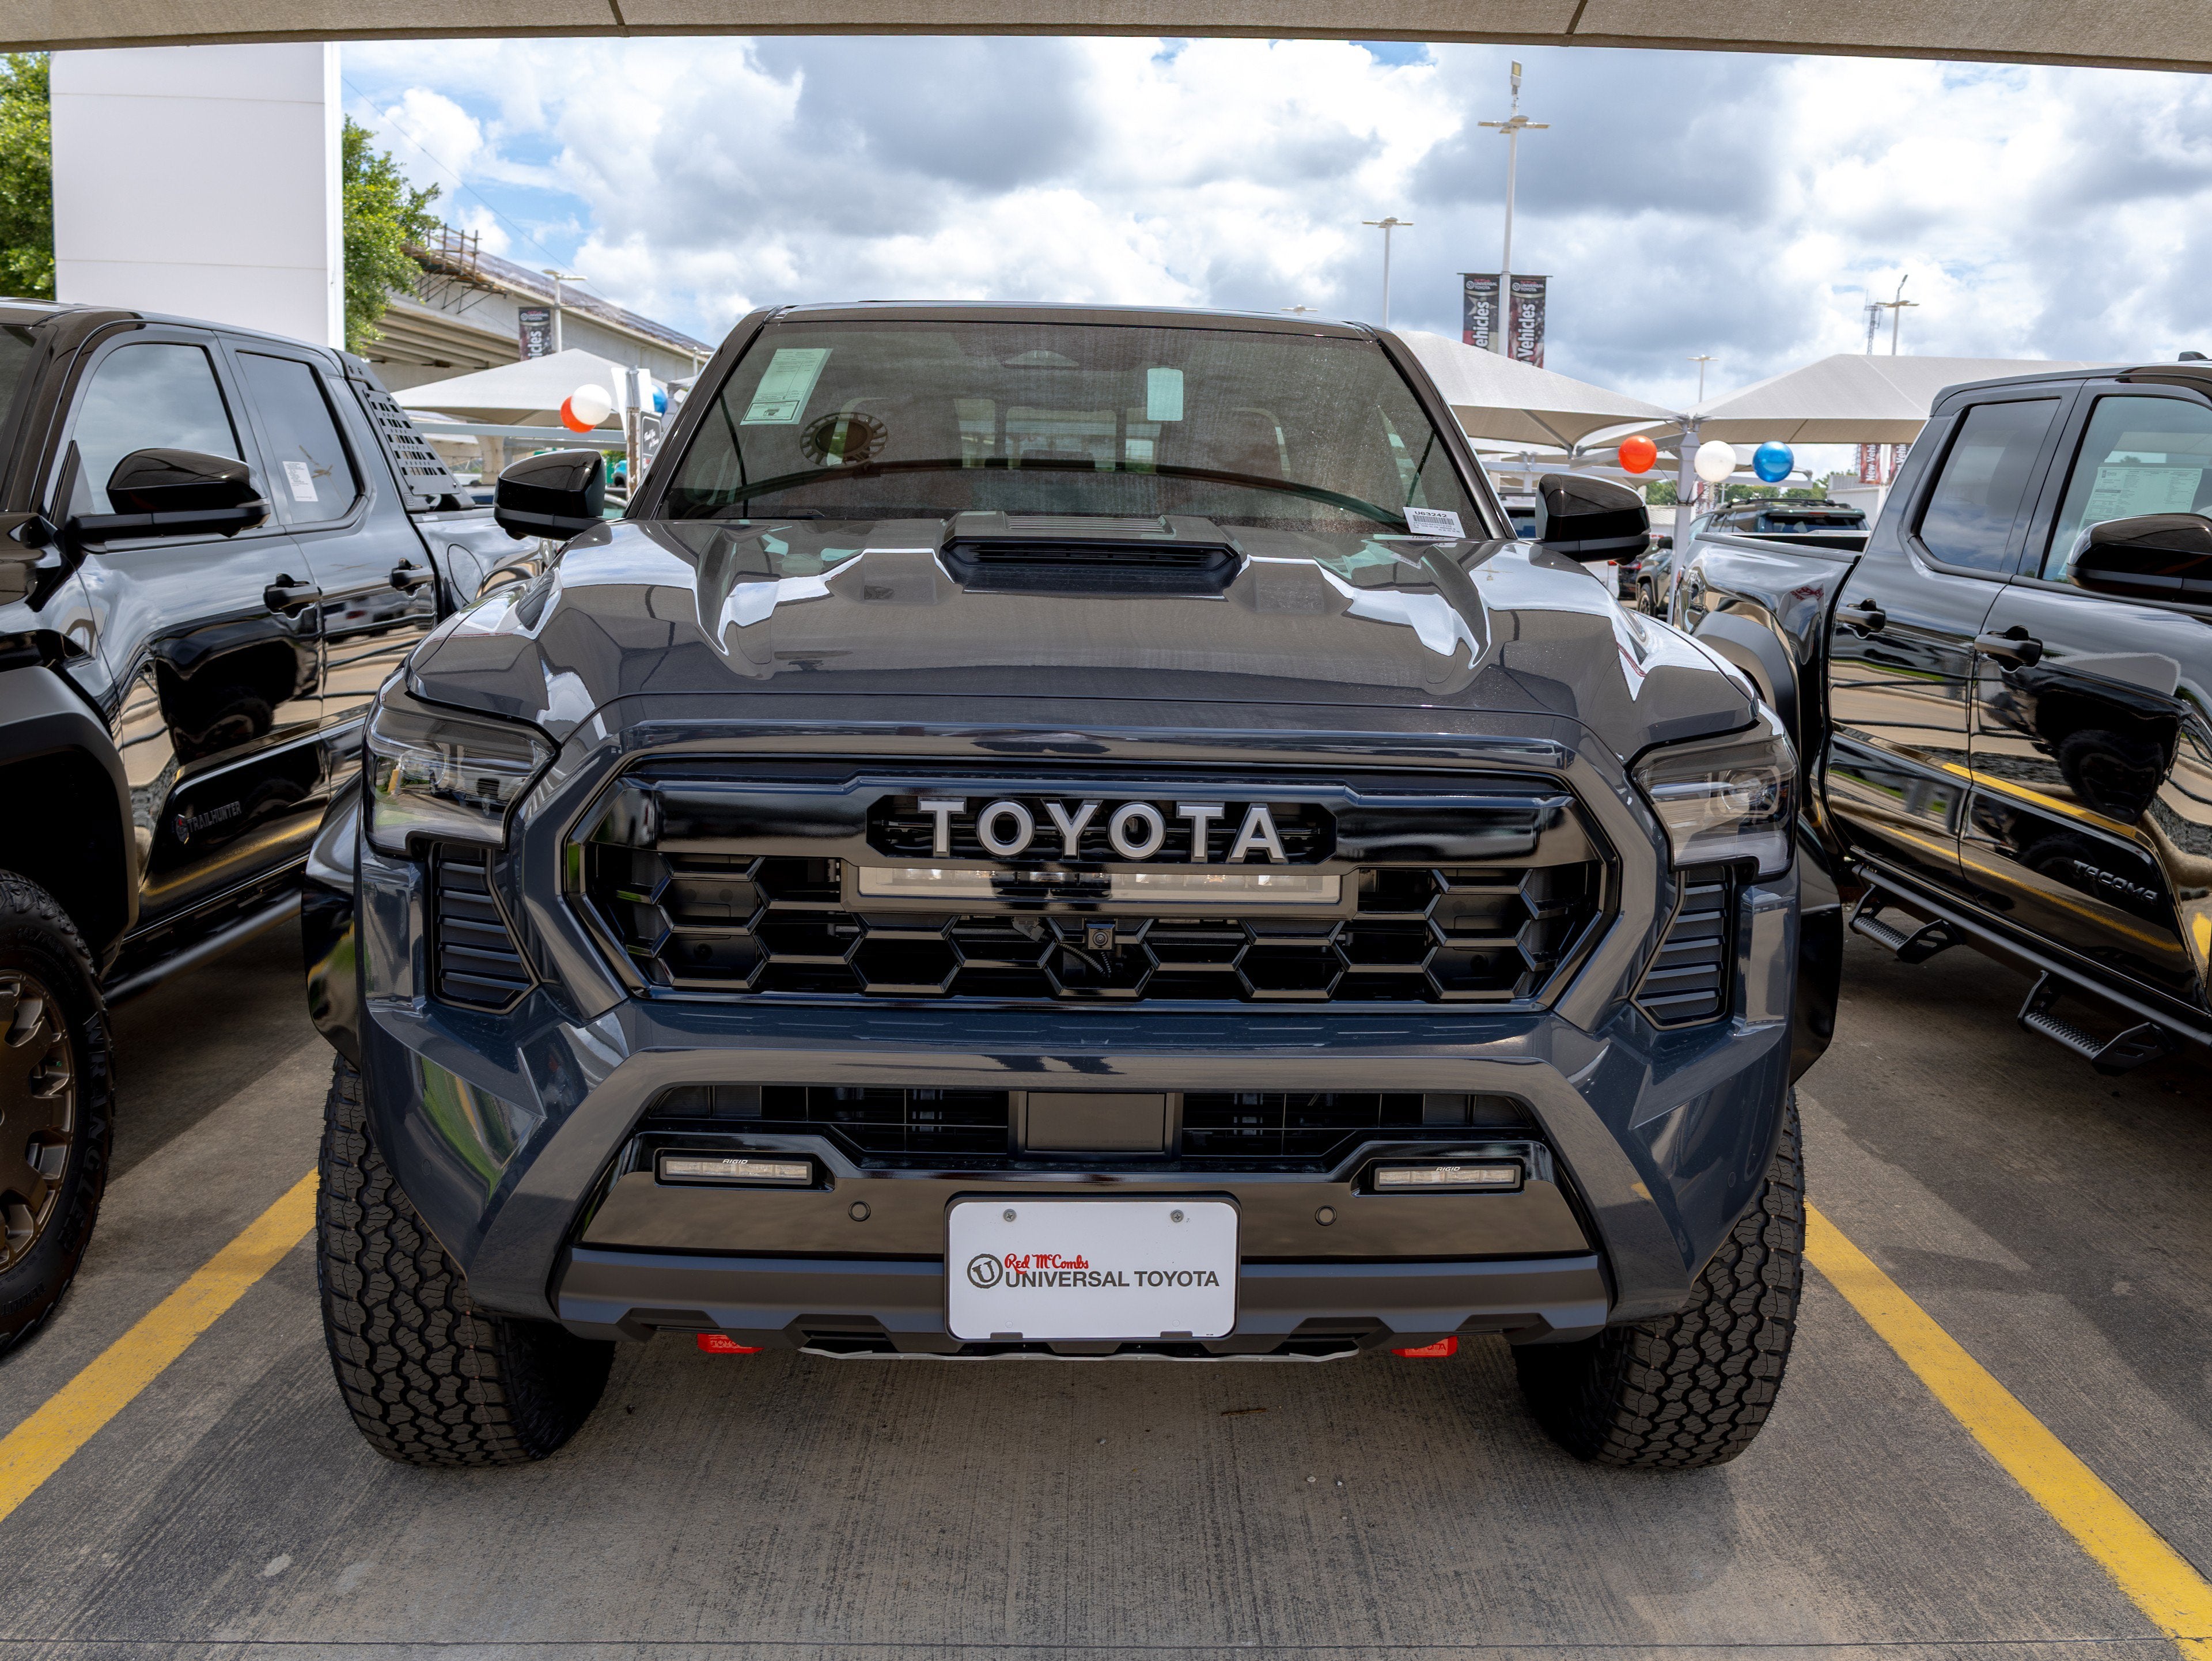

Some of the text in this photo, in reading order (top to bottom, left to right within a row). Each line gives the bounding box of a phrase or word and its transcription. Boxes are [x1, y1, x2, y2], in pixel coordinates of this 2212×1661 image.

[1472, 301, 1490, 349] ehicles
[1517, 304, 1536, 358] Vehicles
[527, 331, 543, 357] icles
[1866, 444, 1877, 480] New Vehi
[187, 801, 242, 833] TRAILHUNTER
[918, 796, 1289, 863] TOYOTA
[2074, 860, 2158, 906] TACOMA
[1005, 1253, 1089, 1274] Red McCombs
[1005, 1270, 1220, 1288] UNIVERSAL TOYOTA
